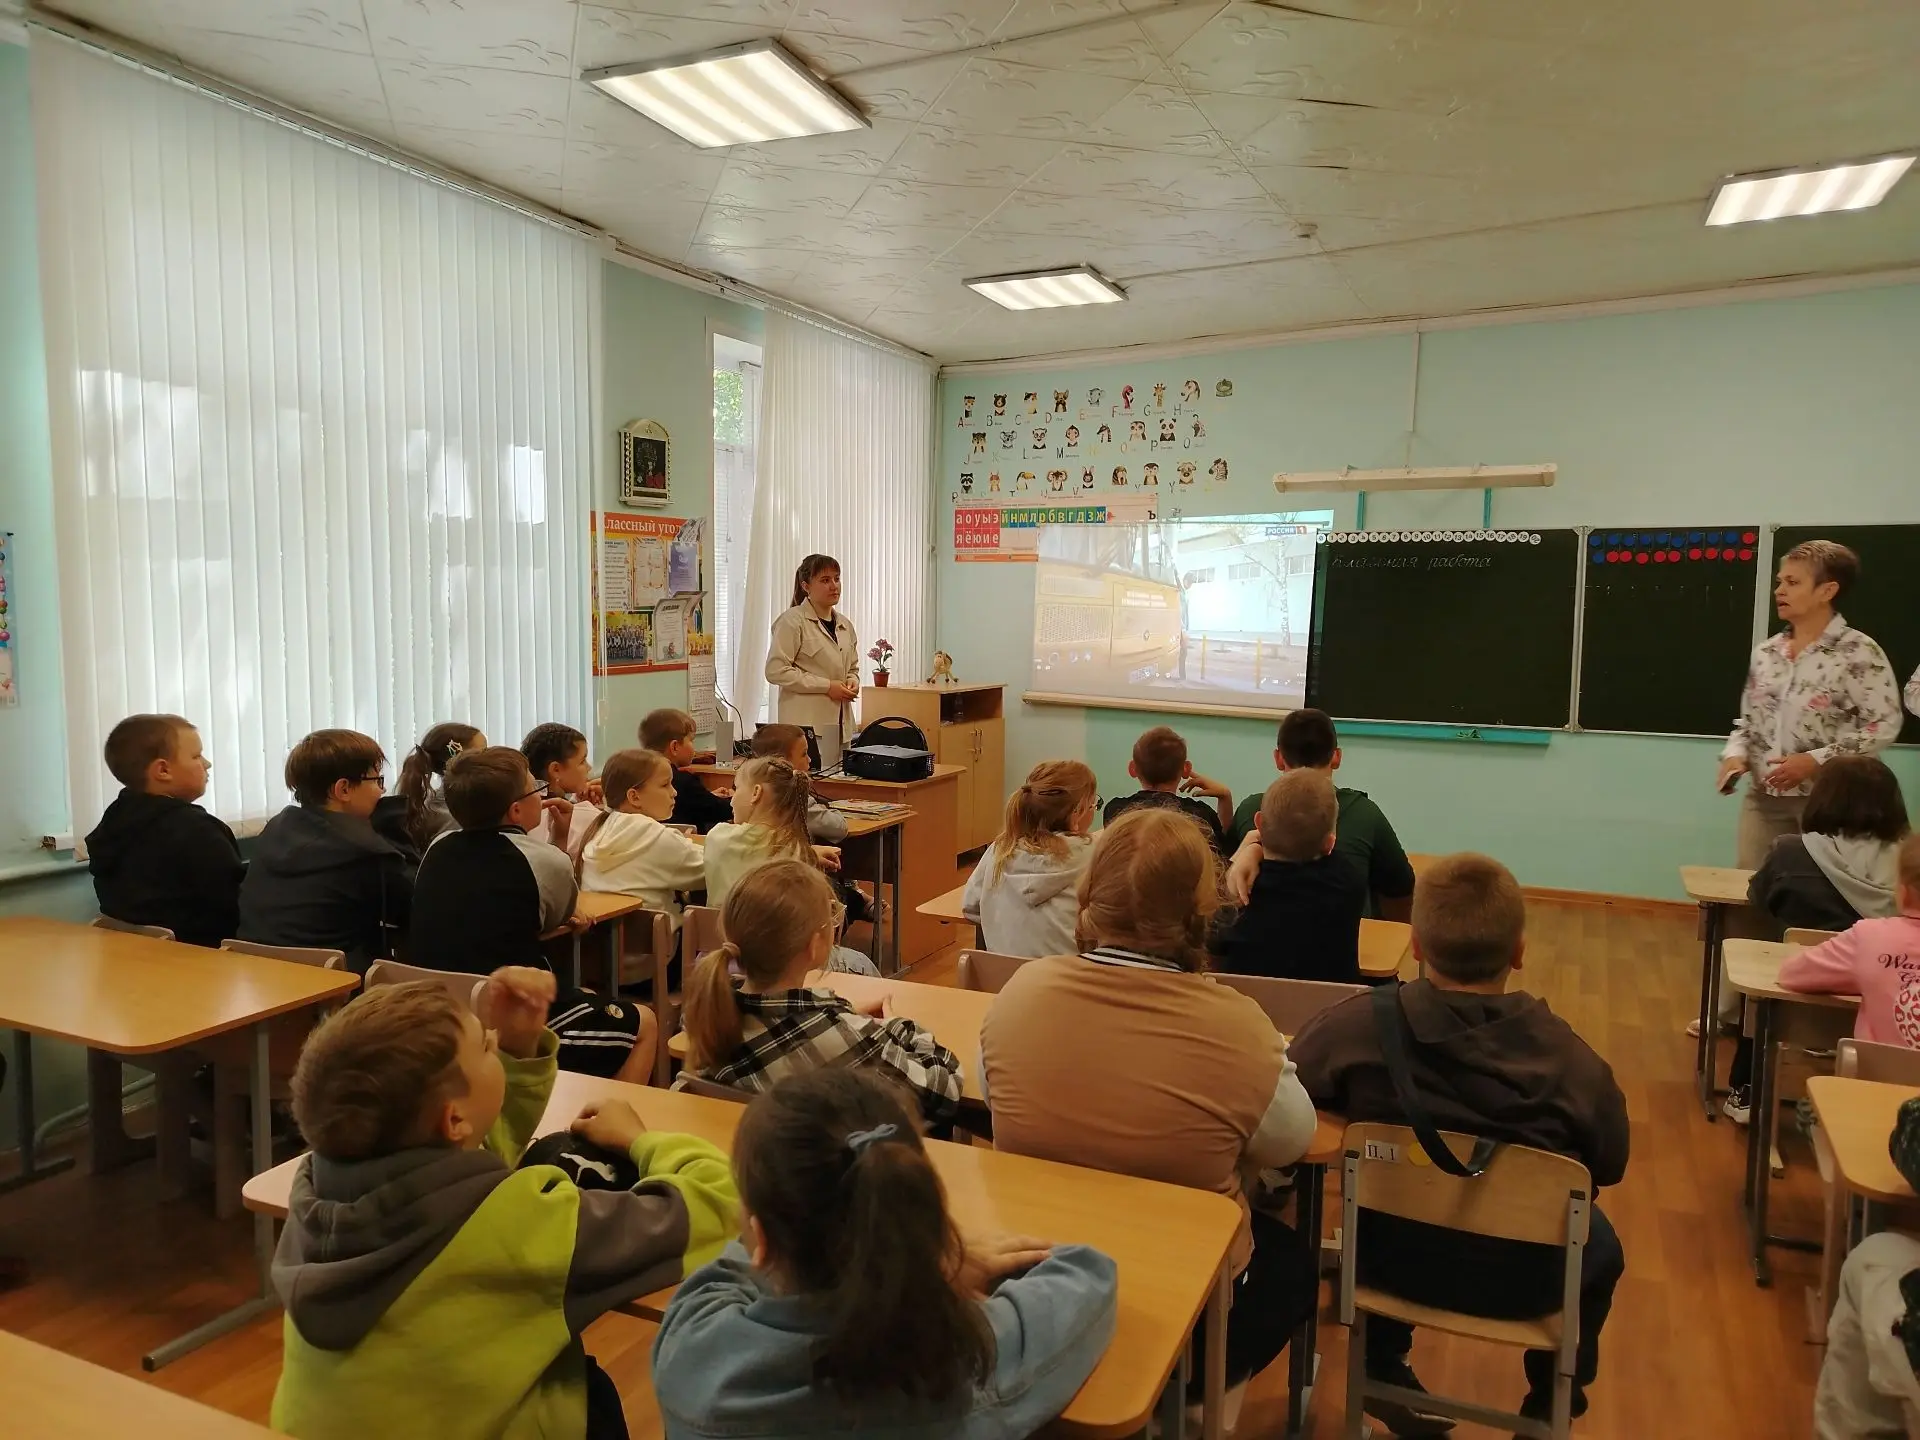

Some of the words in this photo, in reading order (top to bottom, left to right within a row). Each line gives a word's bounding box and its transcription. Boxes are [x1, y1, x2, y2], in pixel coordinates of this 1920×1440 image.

[986, 414, 993, 426] B
[1045, 412, 1052, 424] D
[1111, 405, 1119, 418] F
[1143, 404, 1151, 417] G
[1173, 404, 1181, 416] H
[1023, 447, 1029, 459] L
[1056, 447, 1064, 459] M
[1150, 440, 1158, 452] P
[604, 516, 656, 532] лассный
[1427, 553, 1492, 571] работа
